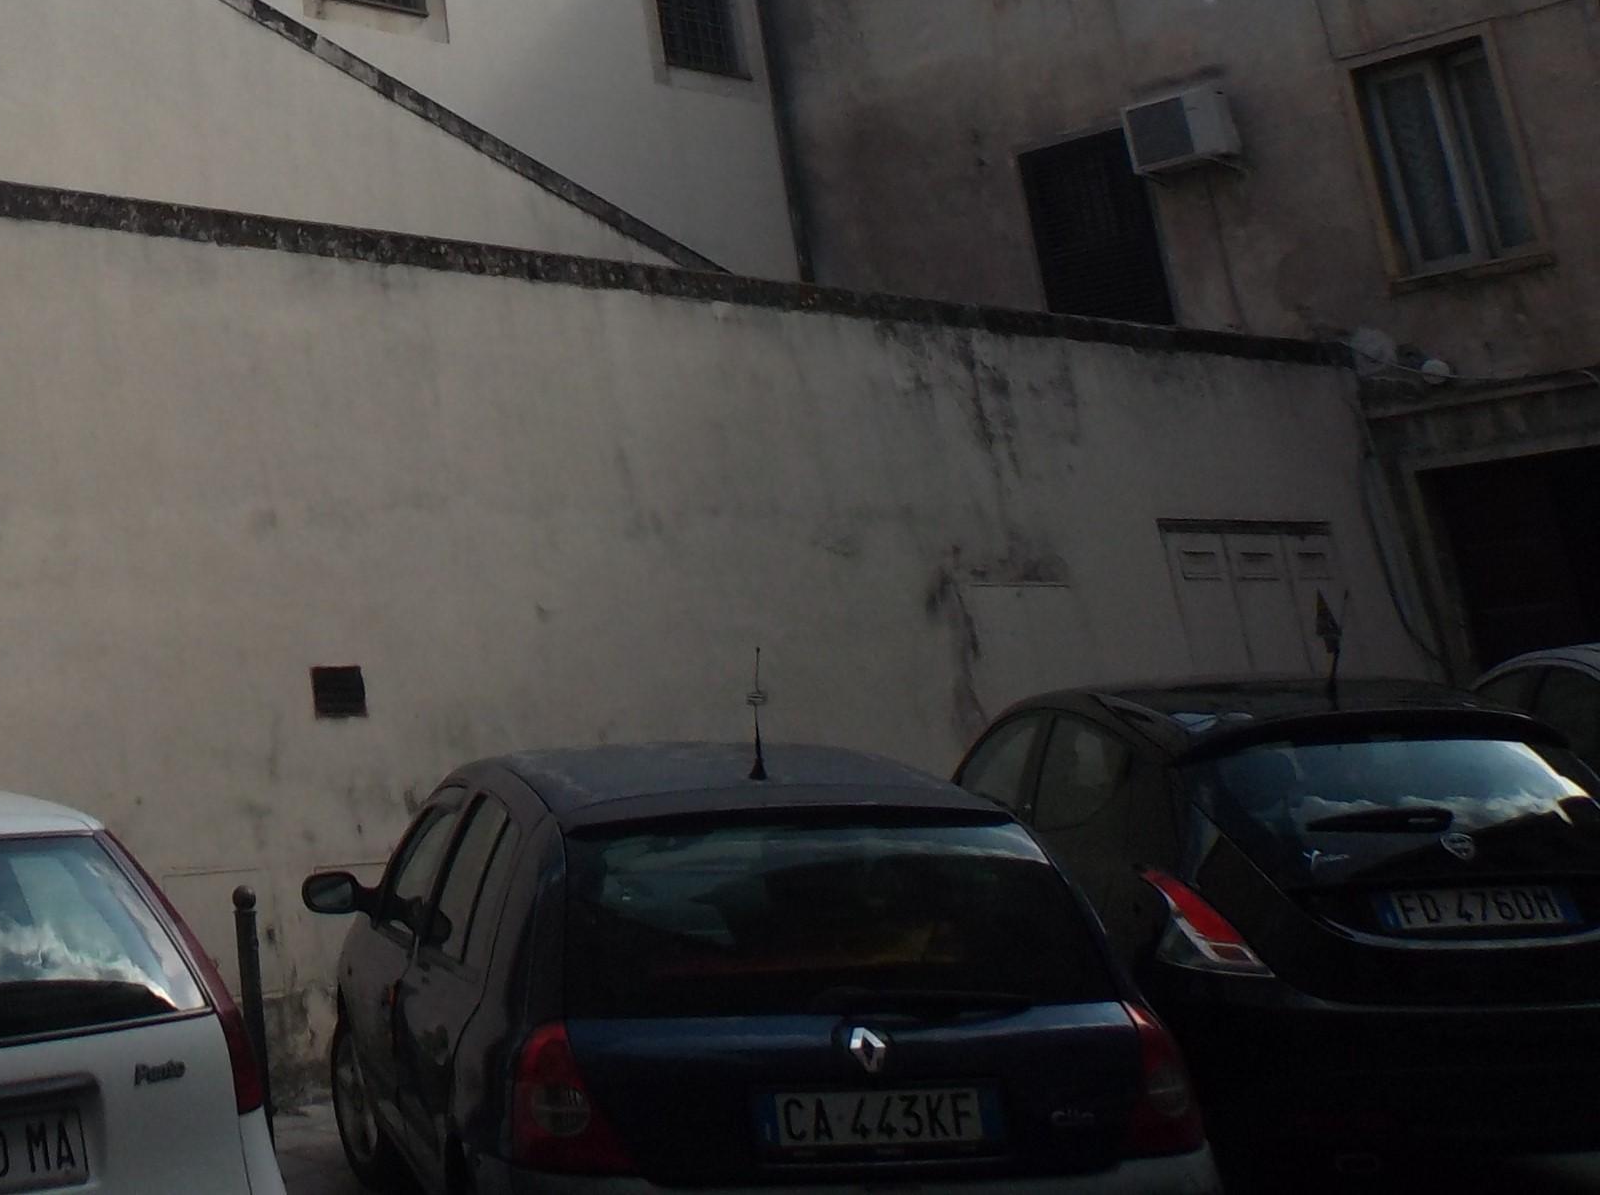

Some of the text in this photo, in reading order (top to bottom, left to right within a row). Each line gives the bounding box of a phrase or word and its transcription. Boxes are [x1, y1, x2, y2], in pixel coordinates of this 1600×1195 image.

[133, 1060, 185, 1086] Punto
[784, 1097, 833, 1141] CA
[851, 1093, 971, 1138] 443KF
[25, 1120, 77, 1173] MA
